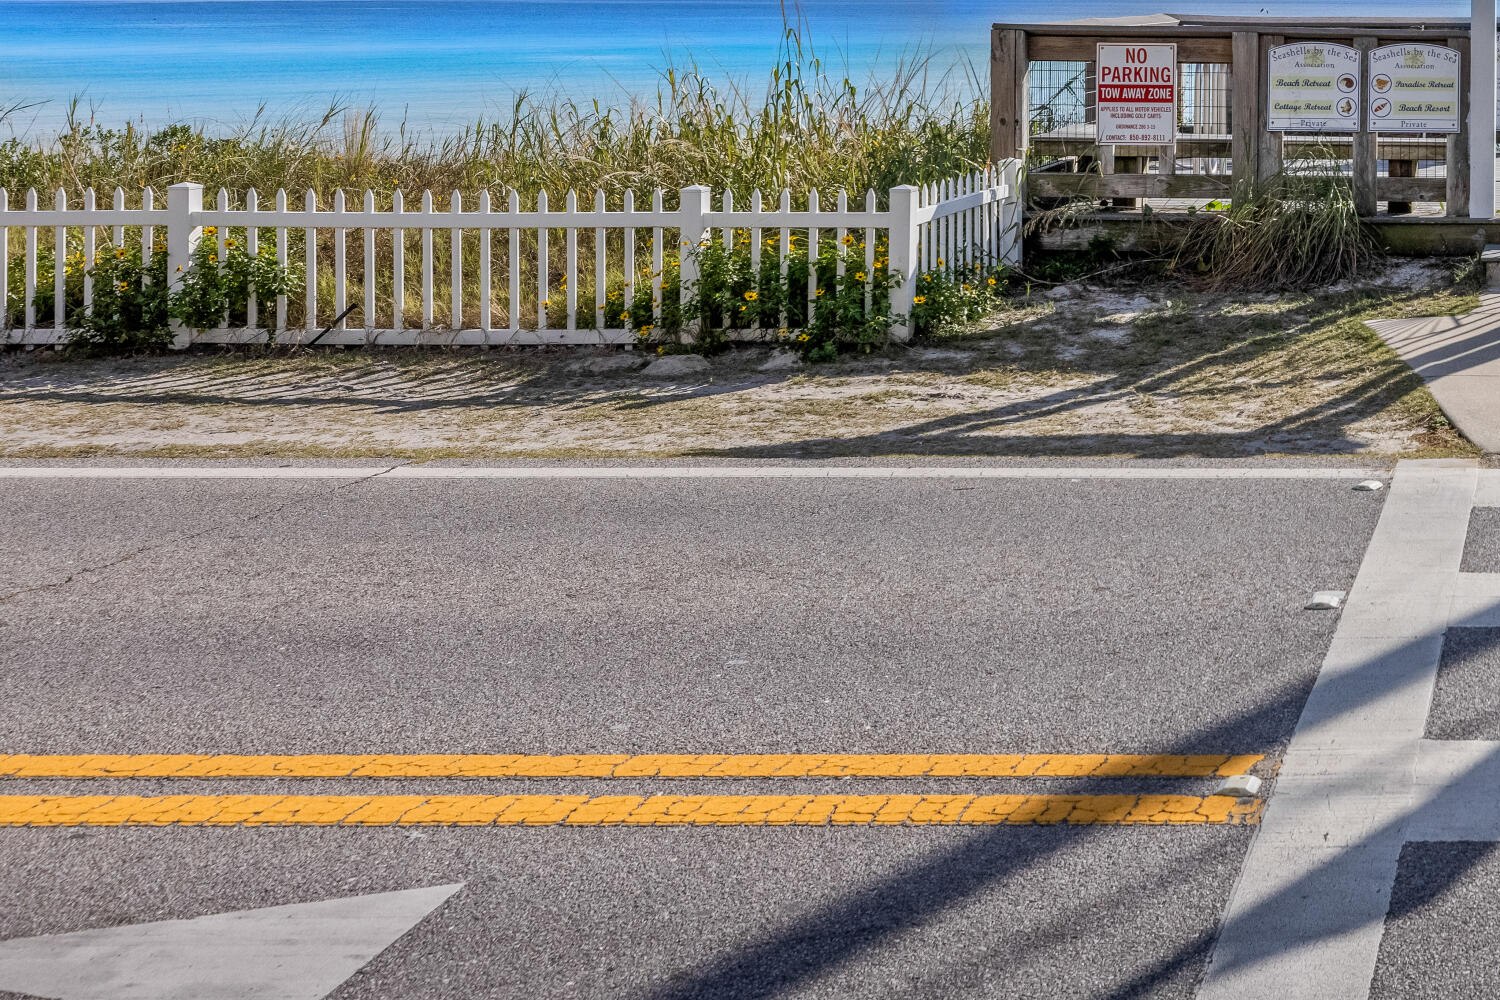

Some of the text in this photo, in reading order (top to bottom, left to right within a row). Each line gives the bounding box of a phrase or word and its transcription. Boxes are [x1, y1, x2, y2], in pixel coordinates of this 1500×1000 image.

[1125, 47, 1147, 64] NO
[1272, 46, 1357, 63] Seashells by the Sea
[1372, 47, 1457, 64] Seashells by the Sea
[1294, 61, 1335, 69] Association
[1394, 62, 1435, 70] Association
[1101, 66, 1171, 83] PARKING
[1275, 78, 1331, 87] Beach Retreat
[1395, 80, 1454, 89] Paradise Retreat
[1101, 87, 1172, 100] TOW AWAY ZONE
[1274, 102, 1332, 112] Cottage Retreat
[1398, 103, 1451, 112] Beach Resort
[1300, 119, 1328, 127] Private
[1401, 120, 1427, 128] Private
